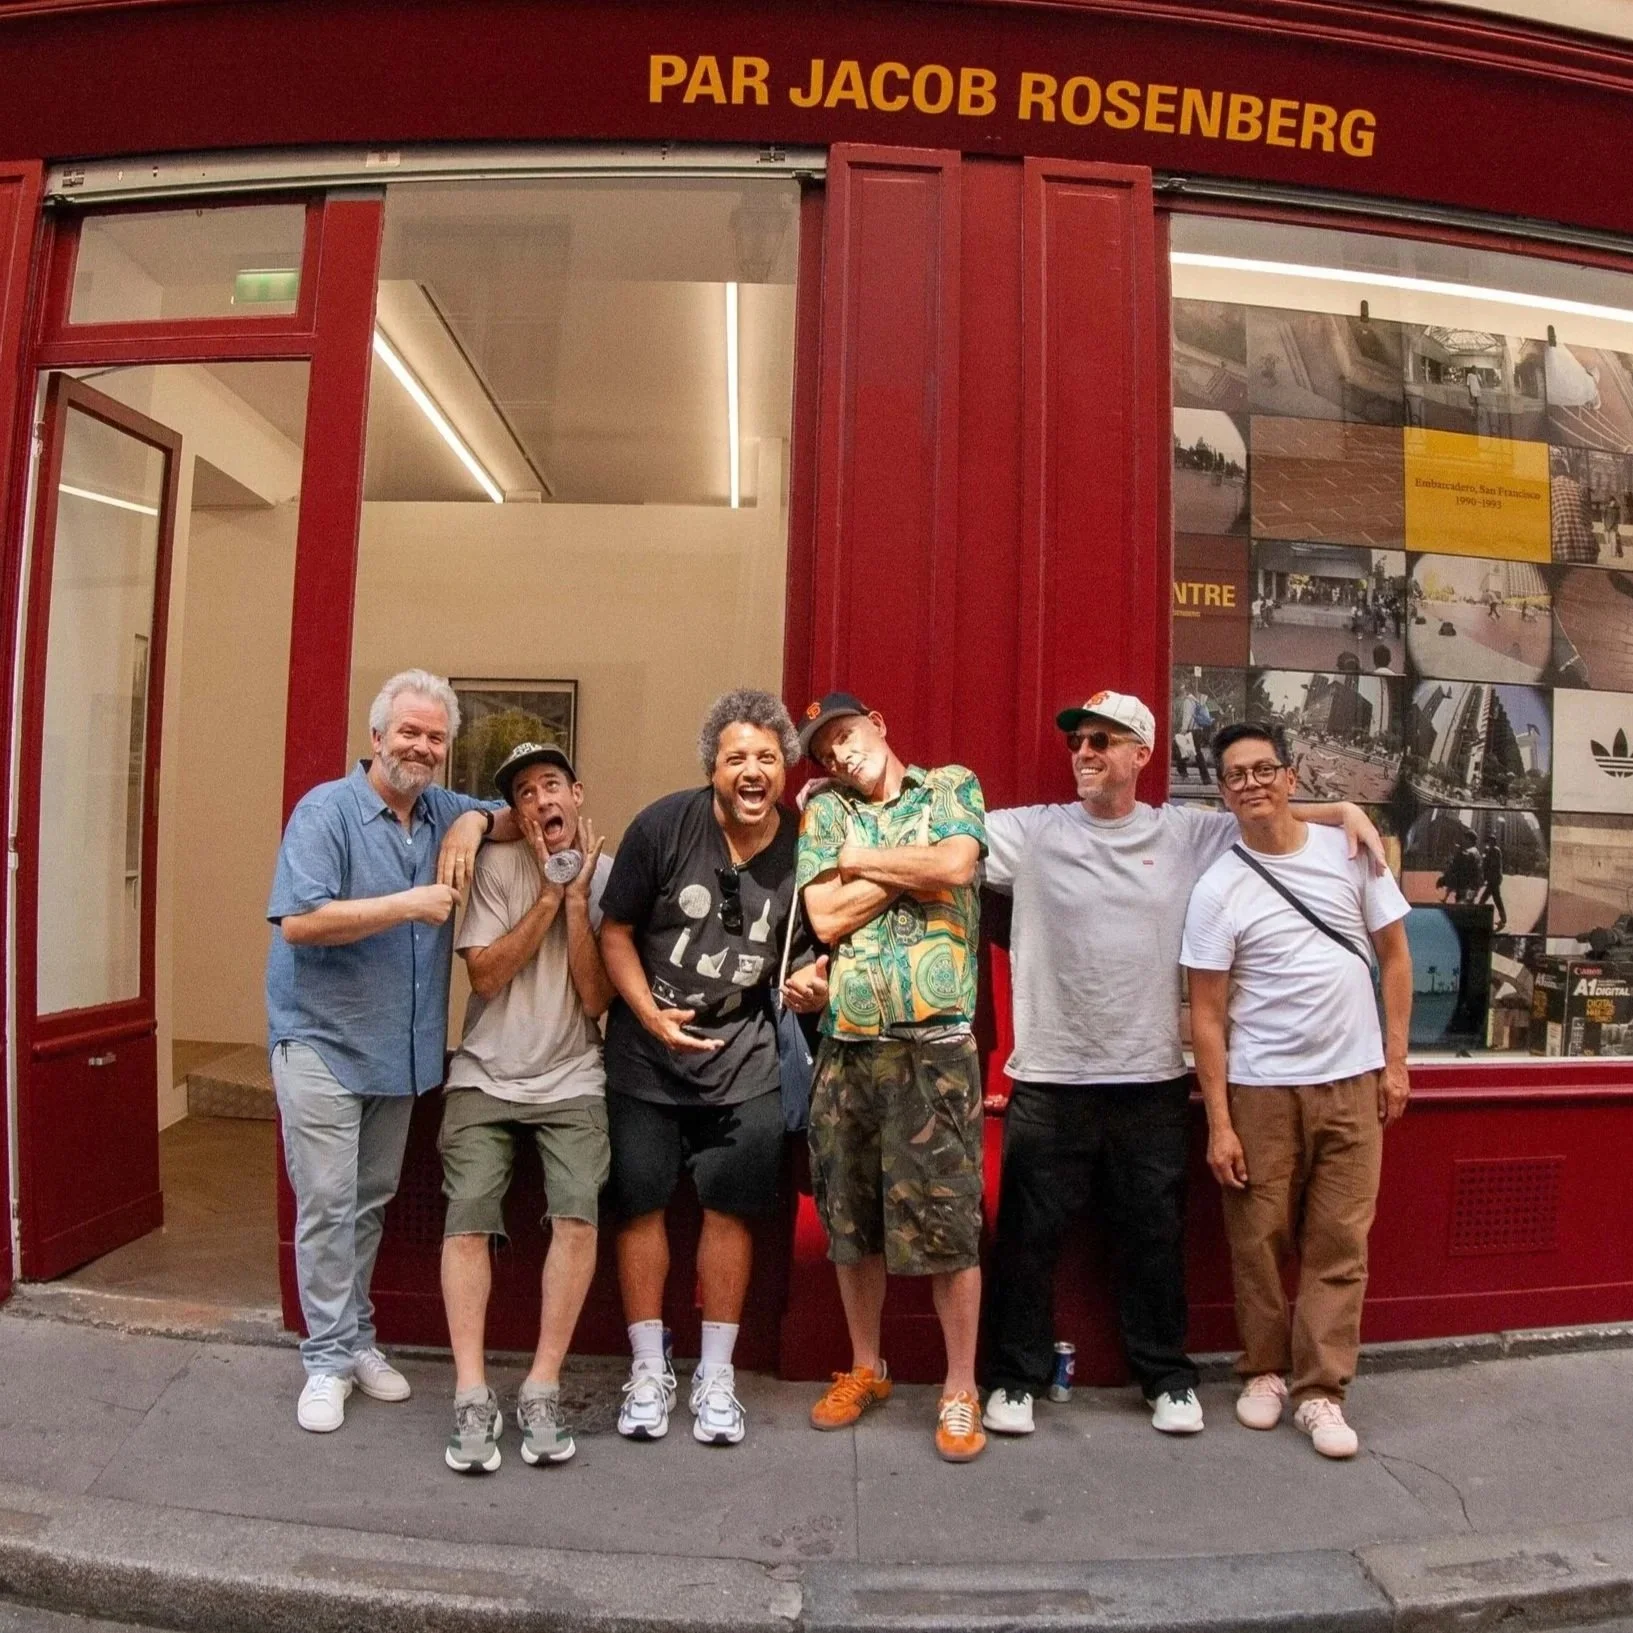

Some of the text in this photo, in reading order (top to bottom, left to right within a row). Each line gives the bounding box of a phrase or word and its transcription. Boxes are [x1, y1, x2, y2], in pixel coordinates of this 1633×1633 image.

[649, 54, 1378, 158] PAR JACOB ROSENBERG
[1415, 478, 1541, 500] Embarcadero, San Francisco
[1573, 978, 1597, 996] A1
[1595, 987, 1630, 996] DIGITAL
